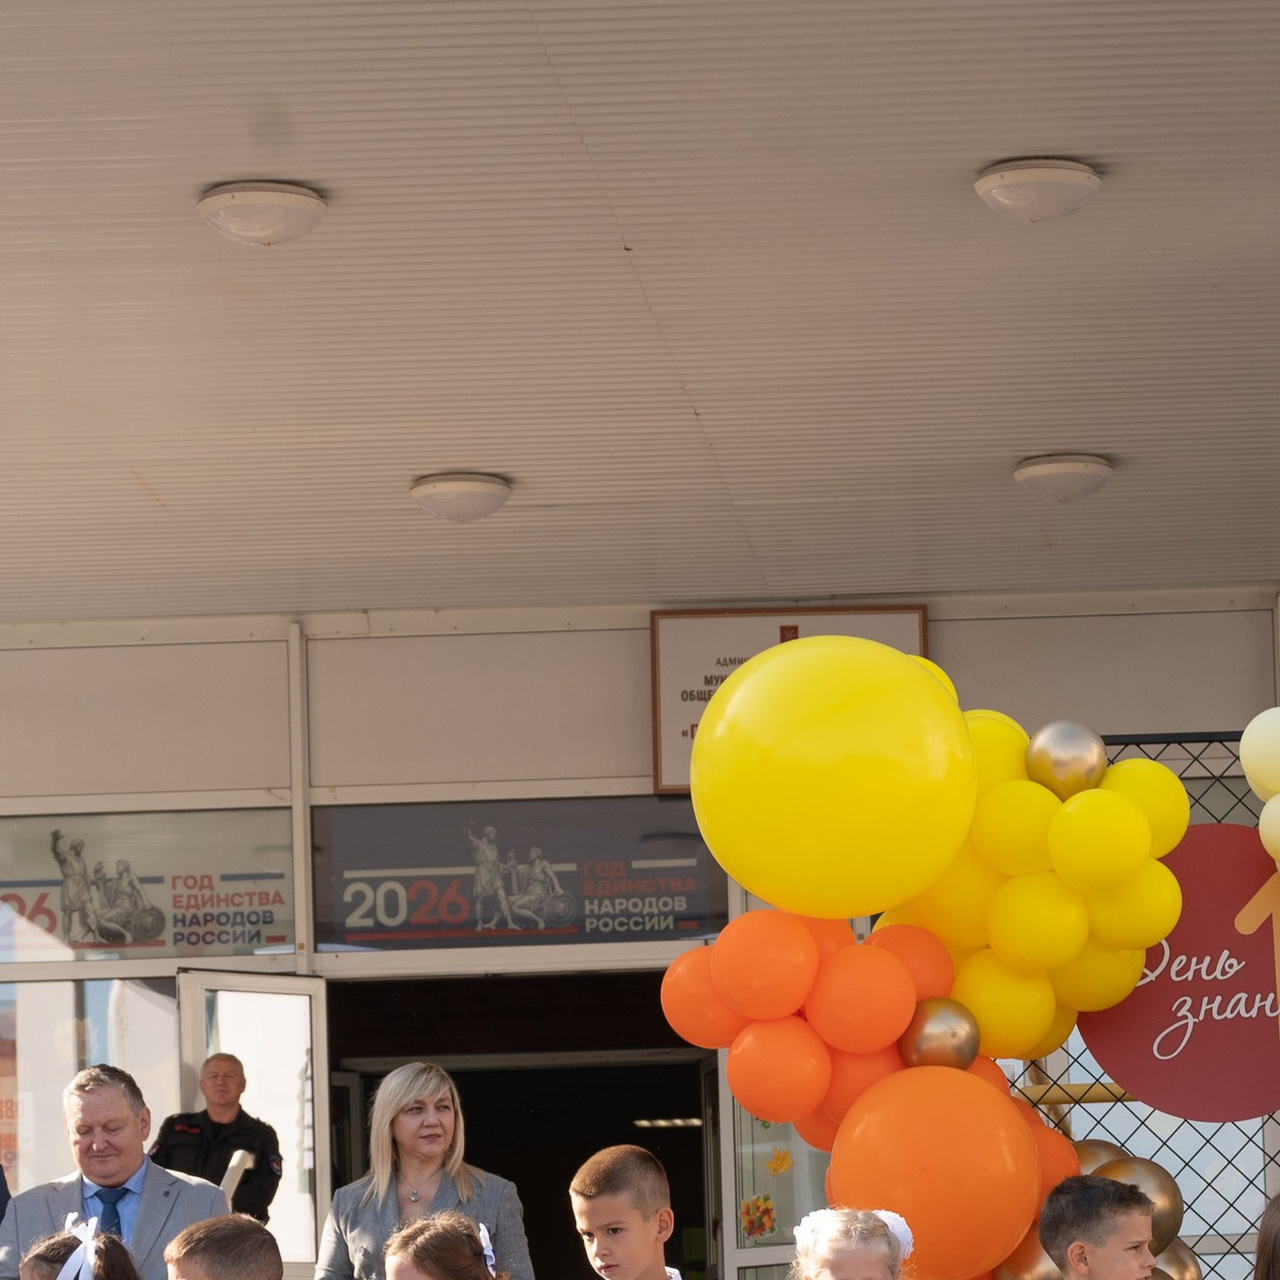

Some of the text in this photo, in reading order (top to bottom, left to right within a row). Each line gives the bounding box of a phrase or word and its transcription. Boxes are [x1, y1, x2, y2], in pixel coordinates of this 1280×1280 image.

[584, 860, 627, 879] ГОД
[171, 873, 215, 893] ГОД
[584, 876, 698, 897] ЕДИНСТВА
[171, 891, 285, 912] ЕДИНСТВА
[343, 878, 471, 928] 2026
[584, 896, 688, 916] НАРОДОВ
[172, 909, 275, 929] НАРОДОВ
[584, 914, 675, 933] РОССИИ
[172, 928, 262, 947] РОССИИ
